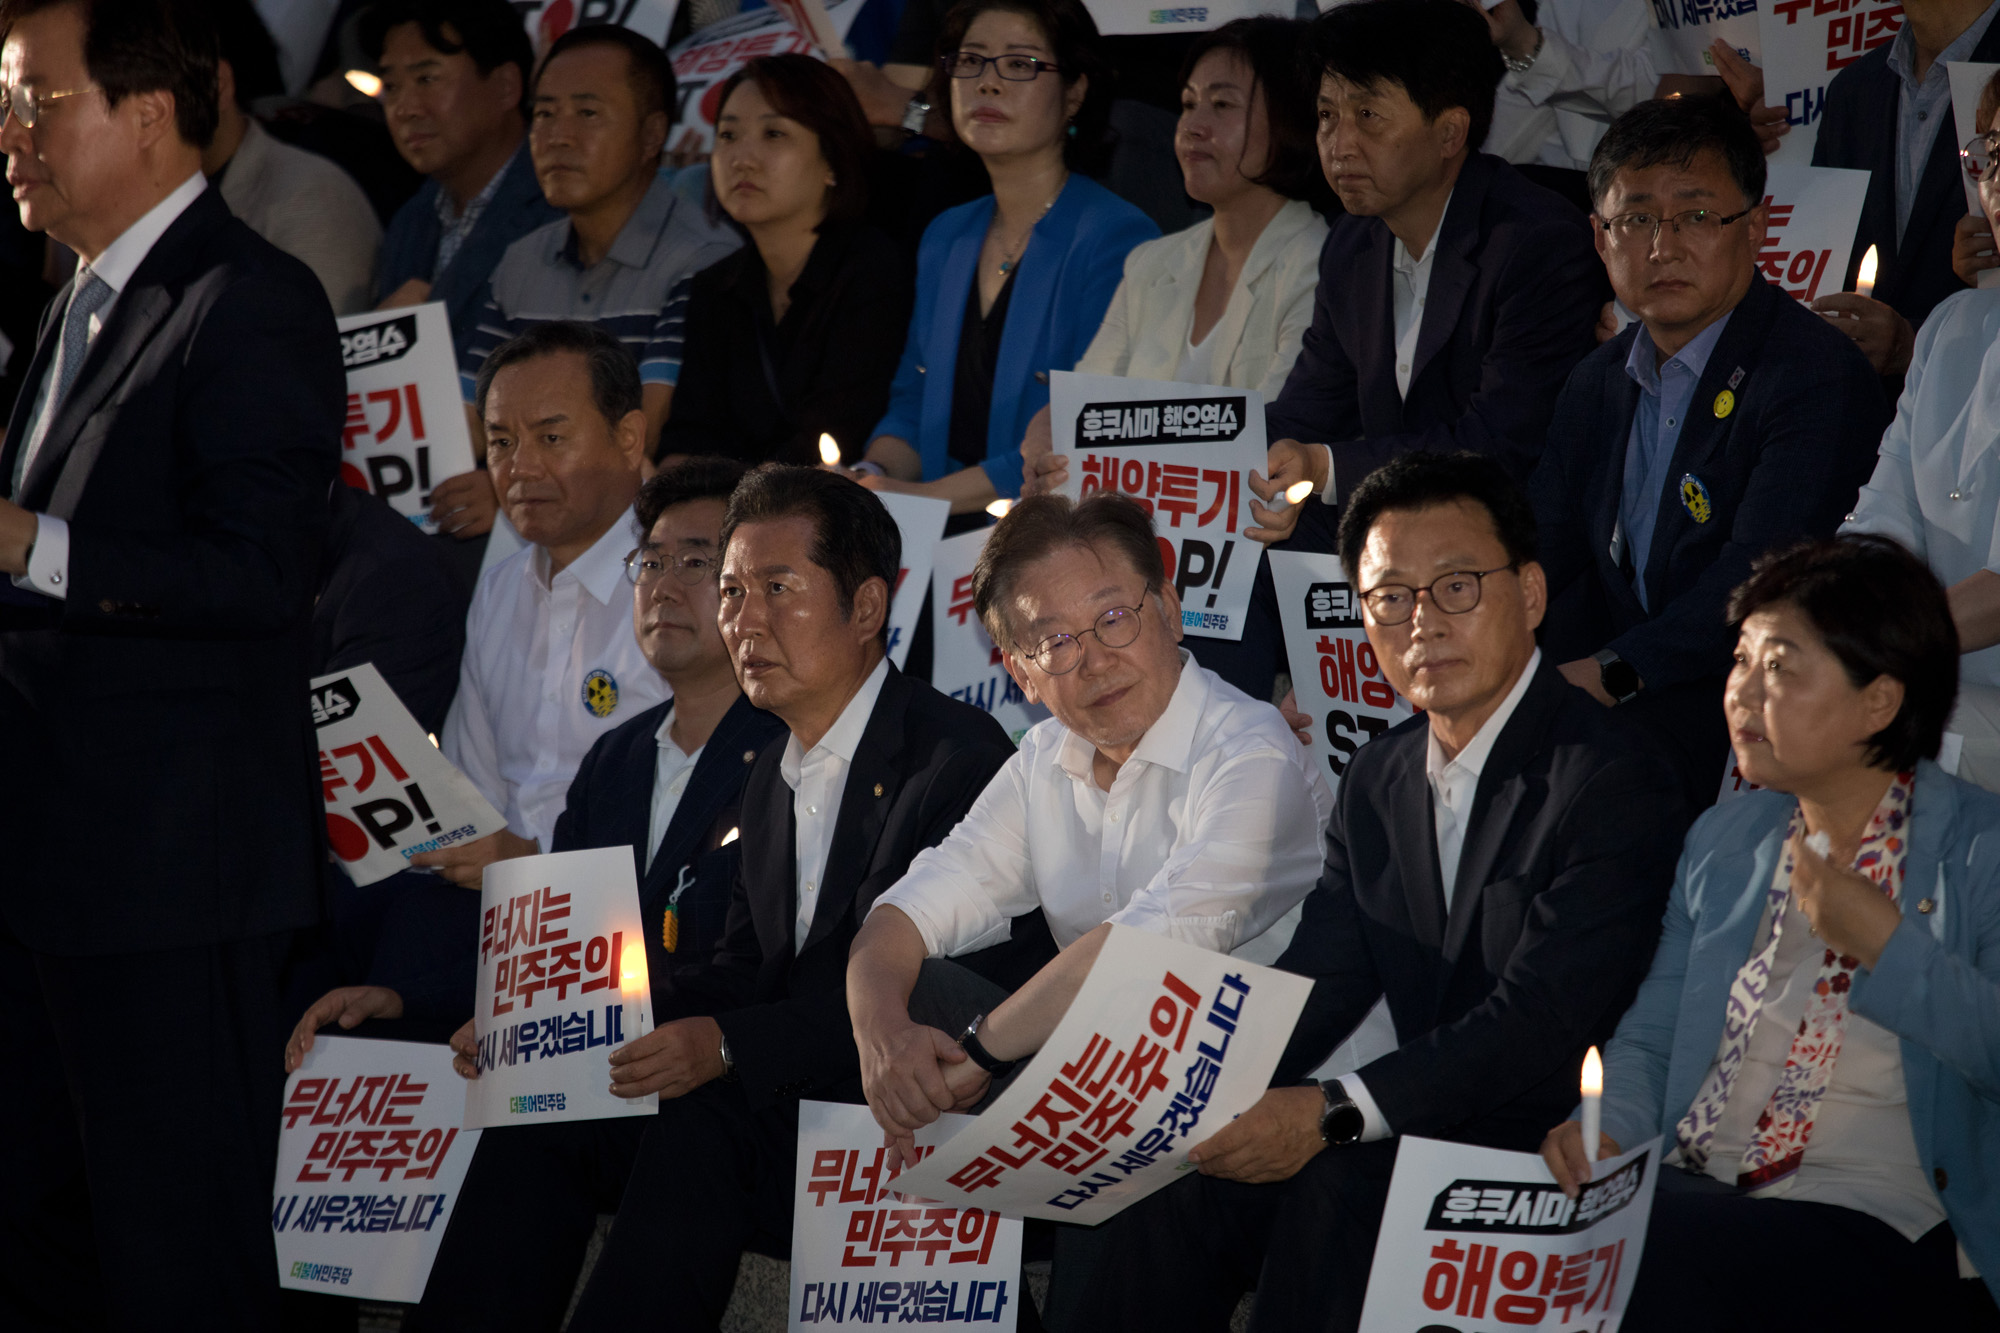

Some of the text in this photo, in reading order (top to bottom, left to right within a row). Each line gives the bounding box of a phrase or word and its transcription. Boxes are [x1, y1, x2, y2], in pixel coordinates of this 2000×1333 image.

[1082, 403, 1239, 442] 후쿠시마 핵오염수
[481, 885, 572, 966] 무너지는
[492, 931, 623, 1018] 민주주의
[282, 1073, 429, 1130] 무너지는
[1040, 970, 1202, 1177] 민주주의
[1046, 972, 1251, 1211] 다시 세우겠습니다
[509, 1092, 567, 1115] 더불어민주당
[946, 1032, 1125, 1194] 무너지는
[296, 1127, 460, 1183] 민주주의
[806, 1145, 945, 1208] 무너
[291, 1193, 446, 1234] 세우겠습니다
[1441, 1186, 1577, 1228] 후쿠시마
[841, 1206, 1002, 1268] 민주주의
[289, 1260, 353, 1285] 더불어민주당
[800, 1280, 1009, 1324] 다시 세우겠습니다
[1422, 1238, 1628, 1326] 해양투기
